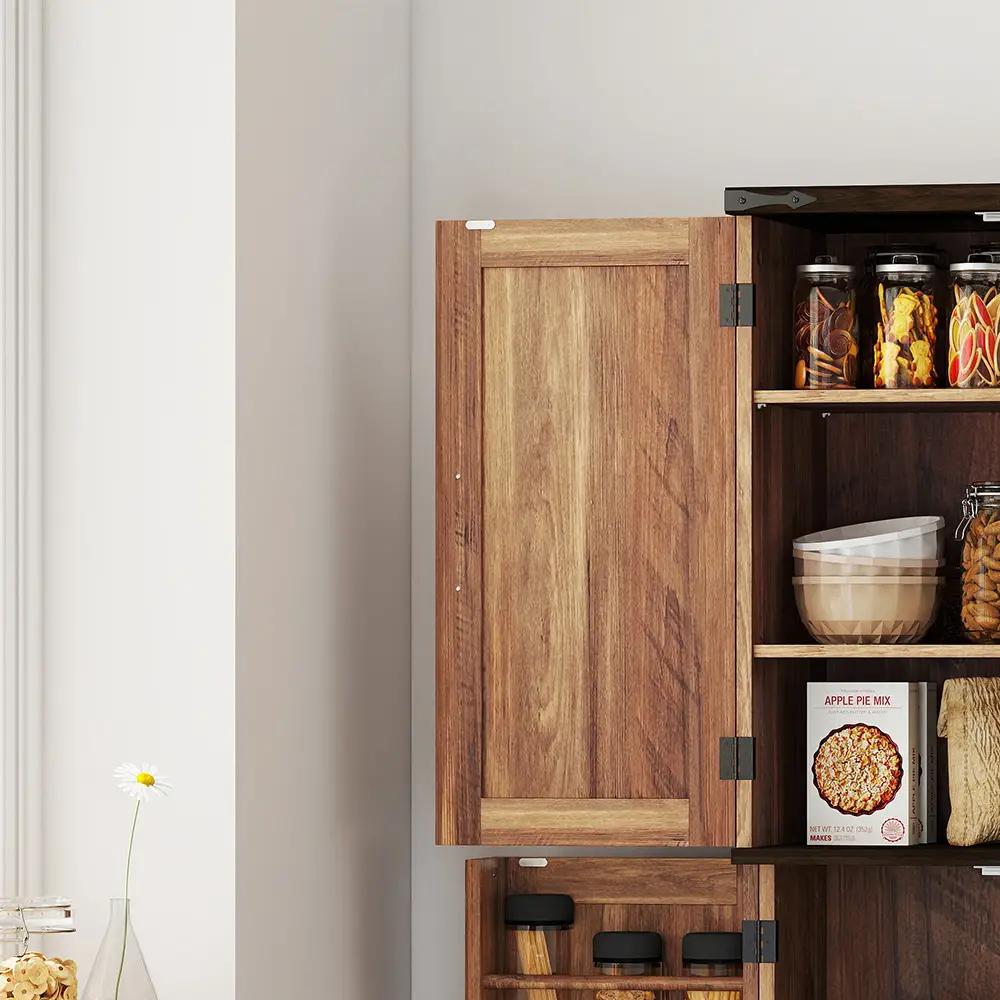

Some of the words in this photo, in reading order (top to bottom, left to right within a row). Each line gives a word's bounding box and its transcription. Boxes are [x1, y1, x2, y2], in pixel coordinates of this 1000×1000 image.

[825, 696, 853, 705] APPLE
[856, 696, 870, 705] PIE
[874, 696, 890, 705] MIX
